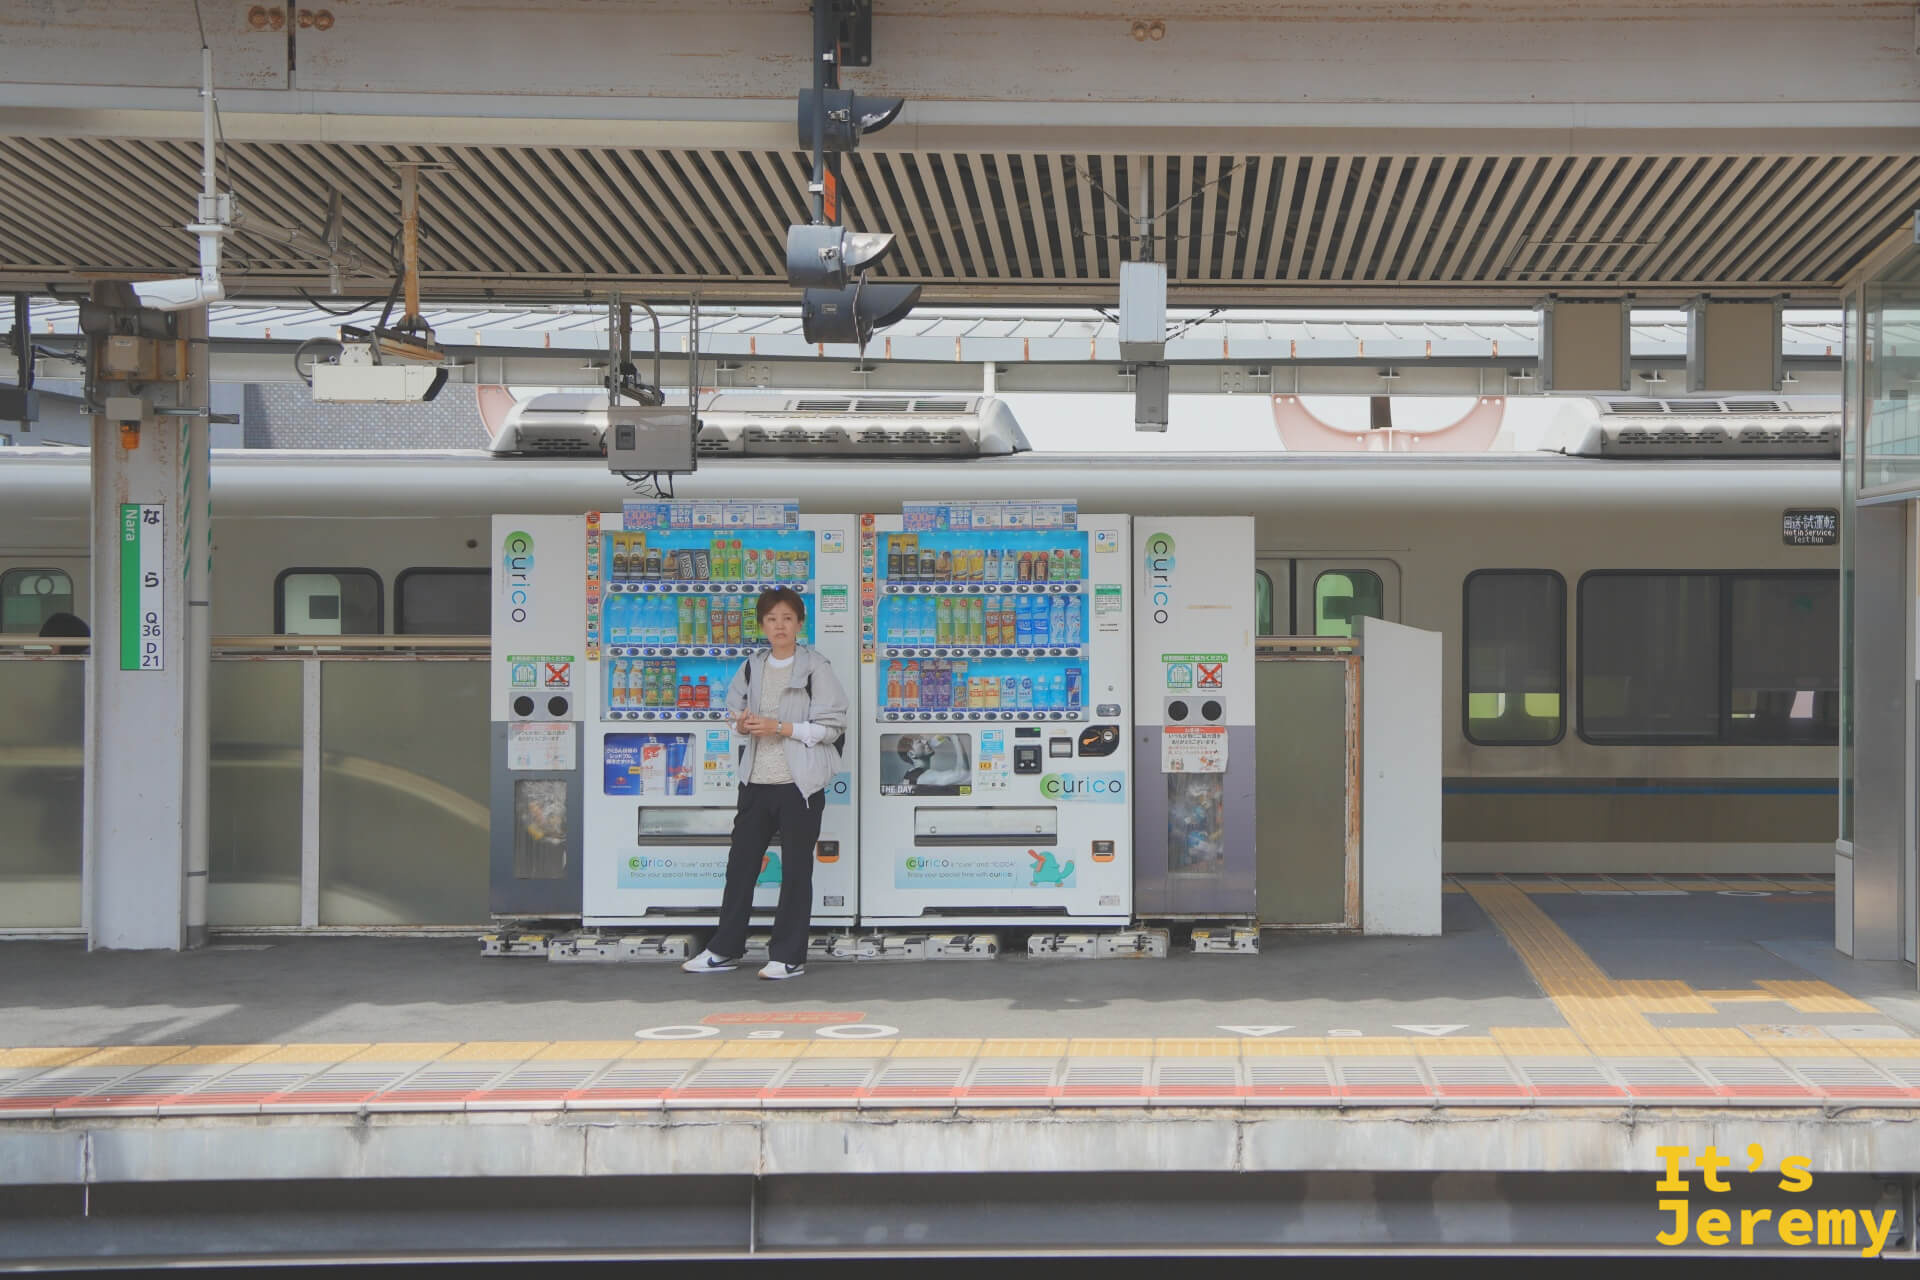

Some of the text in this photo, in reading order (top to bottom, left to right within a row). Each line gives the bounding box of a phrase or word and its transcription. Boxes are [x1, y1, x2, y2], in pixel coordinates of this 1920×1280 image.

[125, 508, 138, 542] Nara
[143, 509, 160, 588] なら
[511, 538, 531, 623] curico
[1153, 540, 1172, 624] curico
[145, 611, 158, 625] Q
[142, 625, 161, 637] 36
[146, 642, 157, 654] D
[142, 655, 161, 667] 21
[1046, 776, 1122, 793] curico
[630, 857, 673, 868] curico
[907, 857, 950, 868] curico
